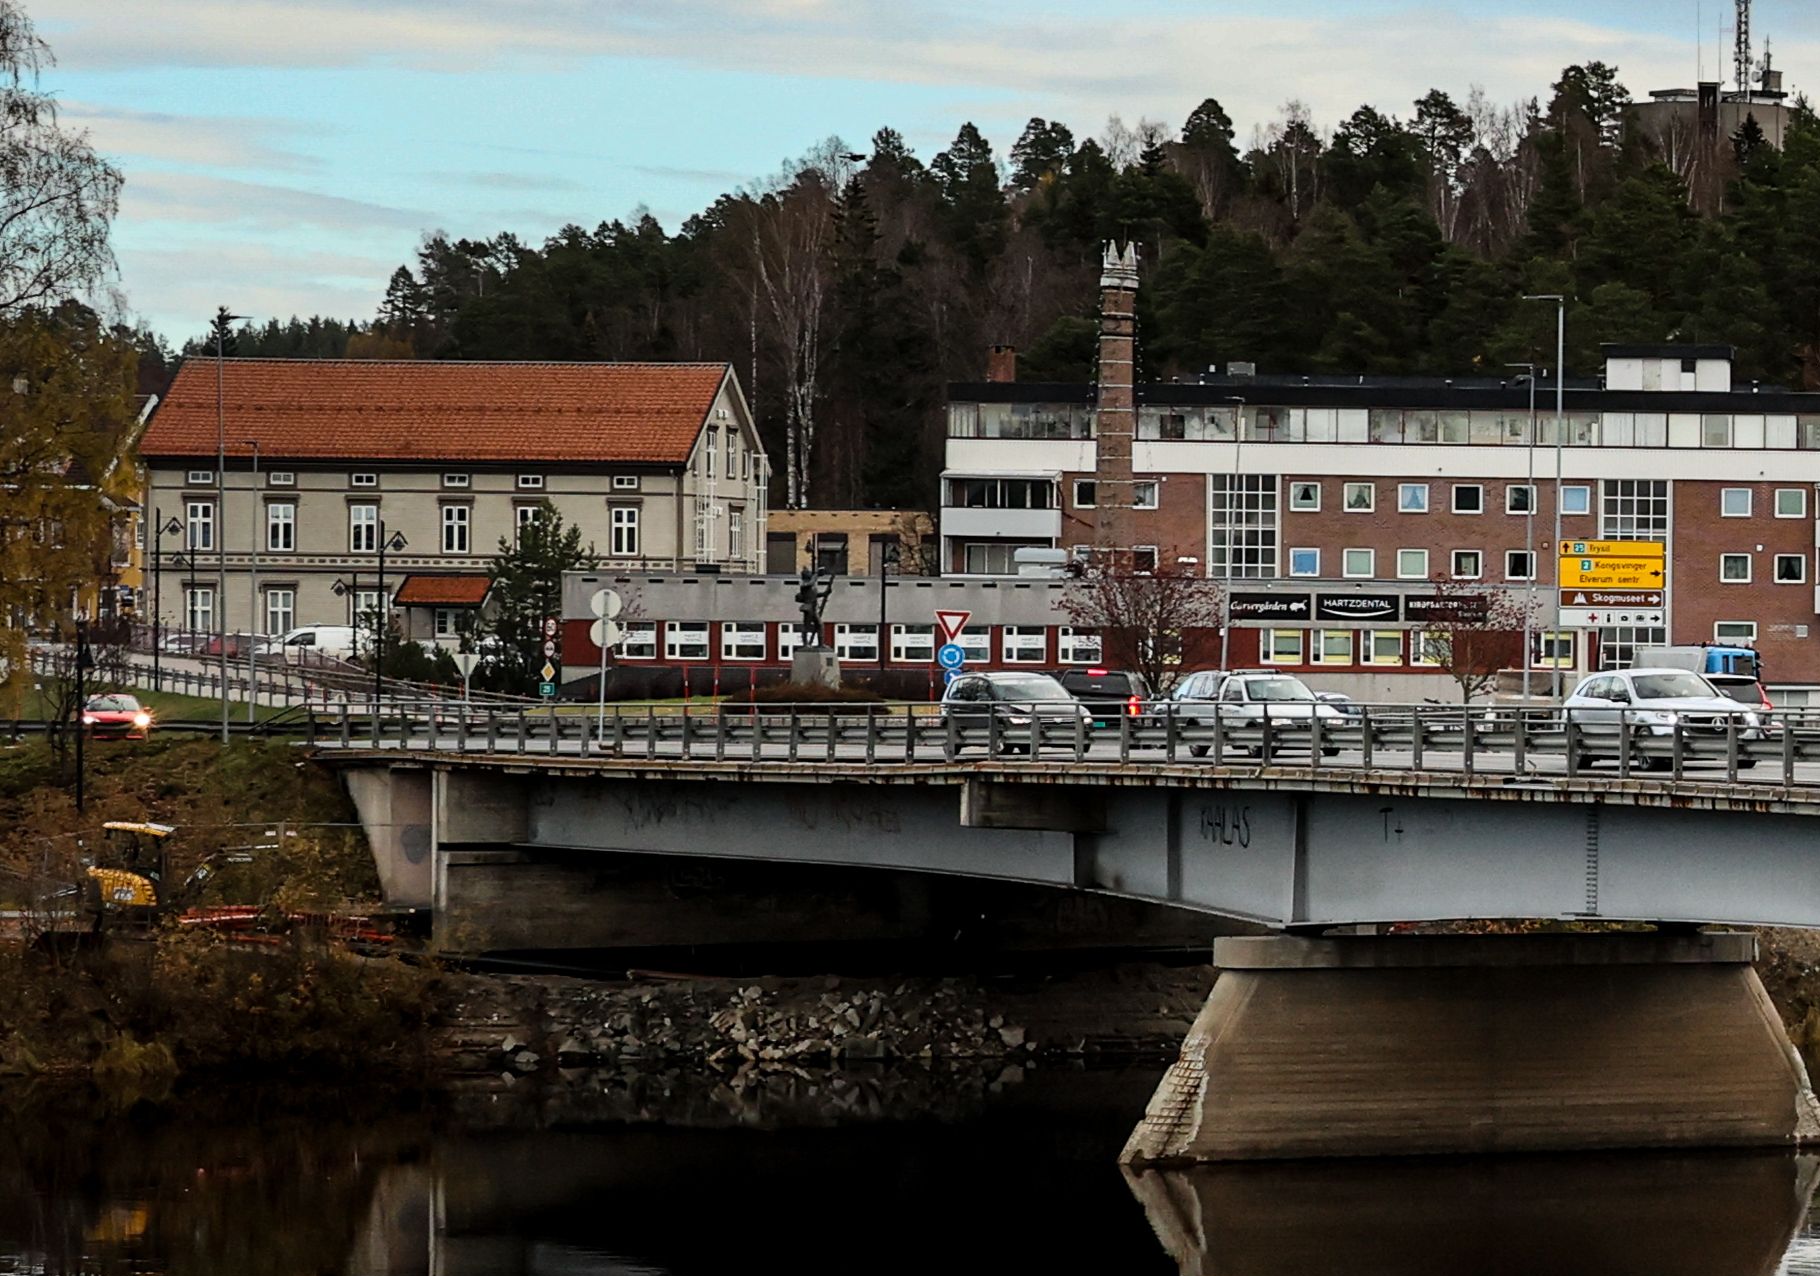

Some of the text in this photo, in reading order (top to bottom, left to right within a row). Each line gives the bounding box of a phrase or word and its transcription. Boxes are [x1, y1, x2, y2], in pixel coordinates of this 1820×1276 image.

[1589, 543, 1611, 553] Trysil
[1594, 562, 1647, 572] Kongsvinger
[1579, 574, 1613, 583] Elverum
[1592, 593, 1645, 604] Skogmuseet
